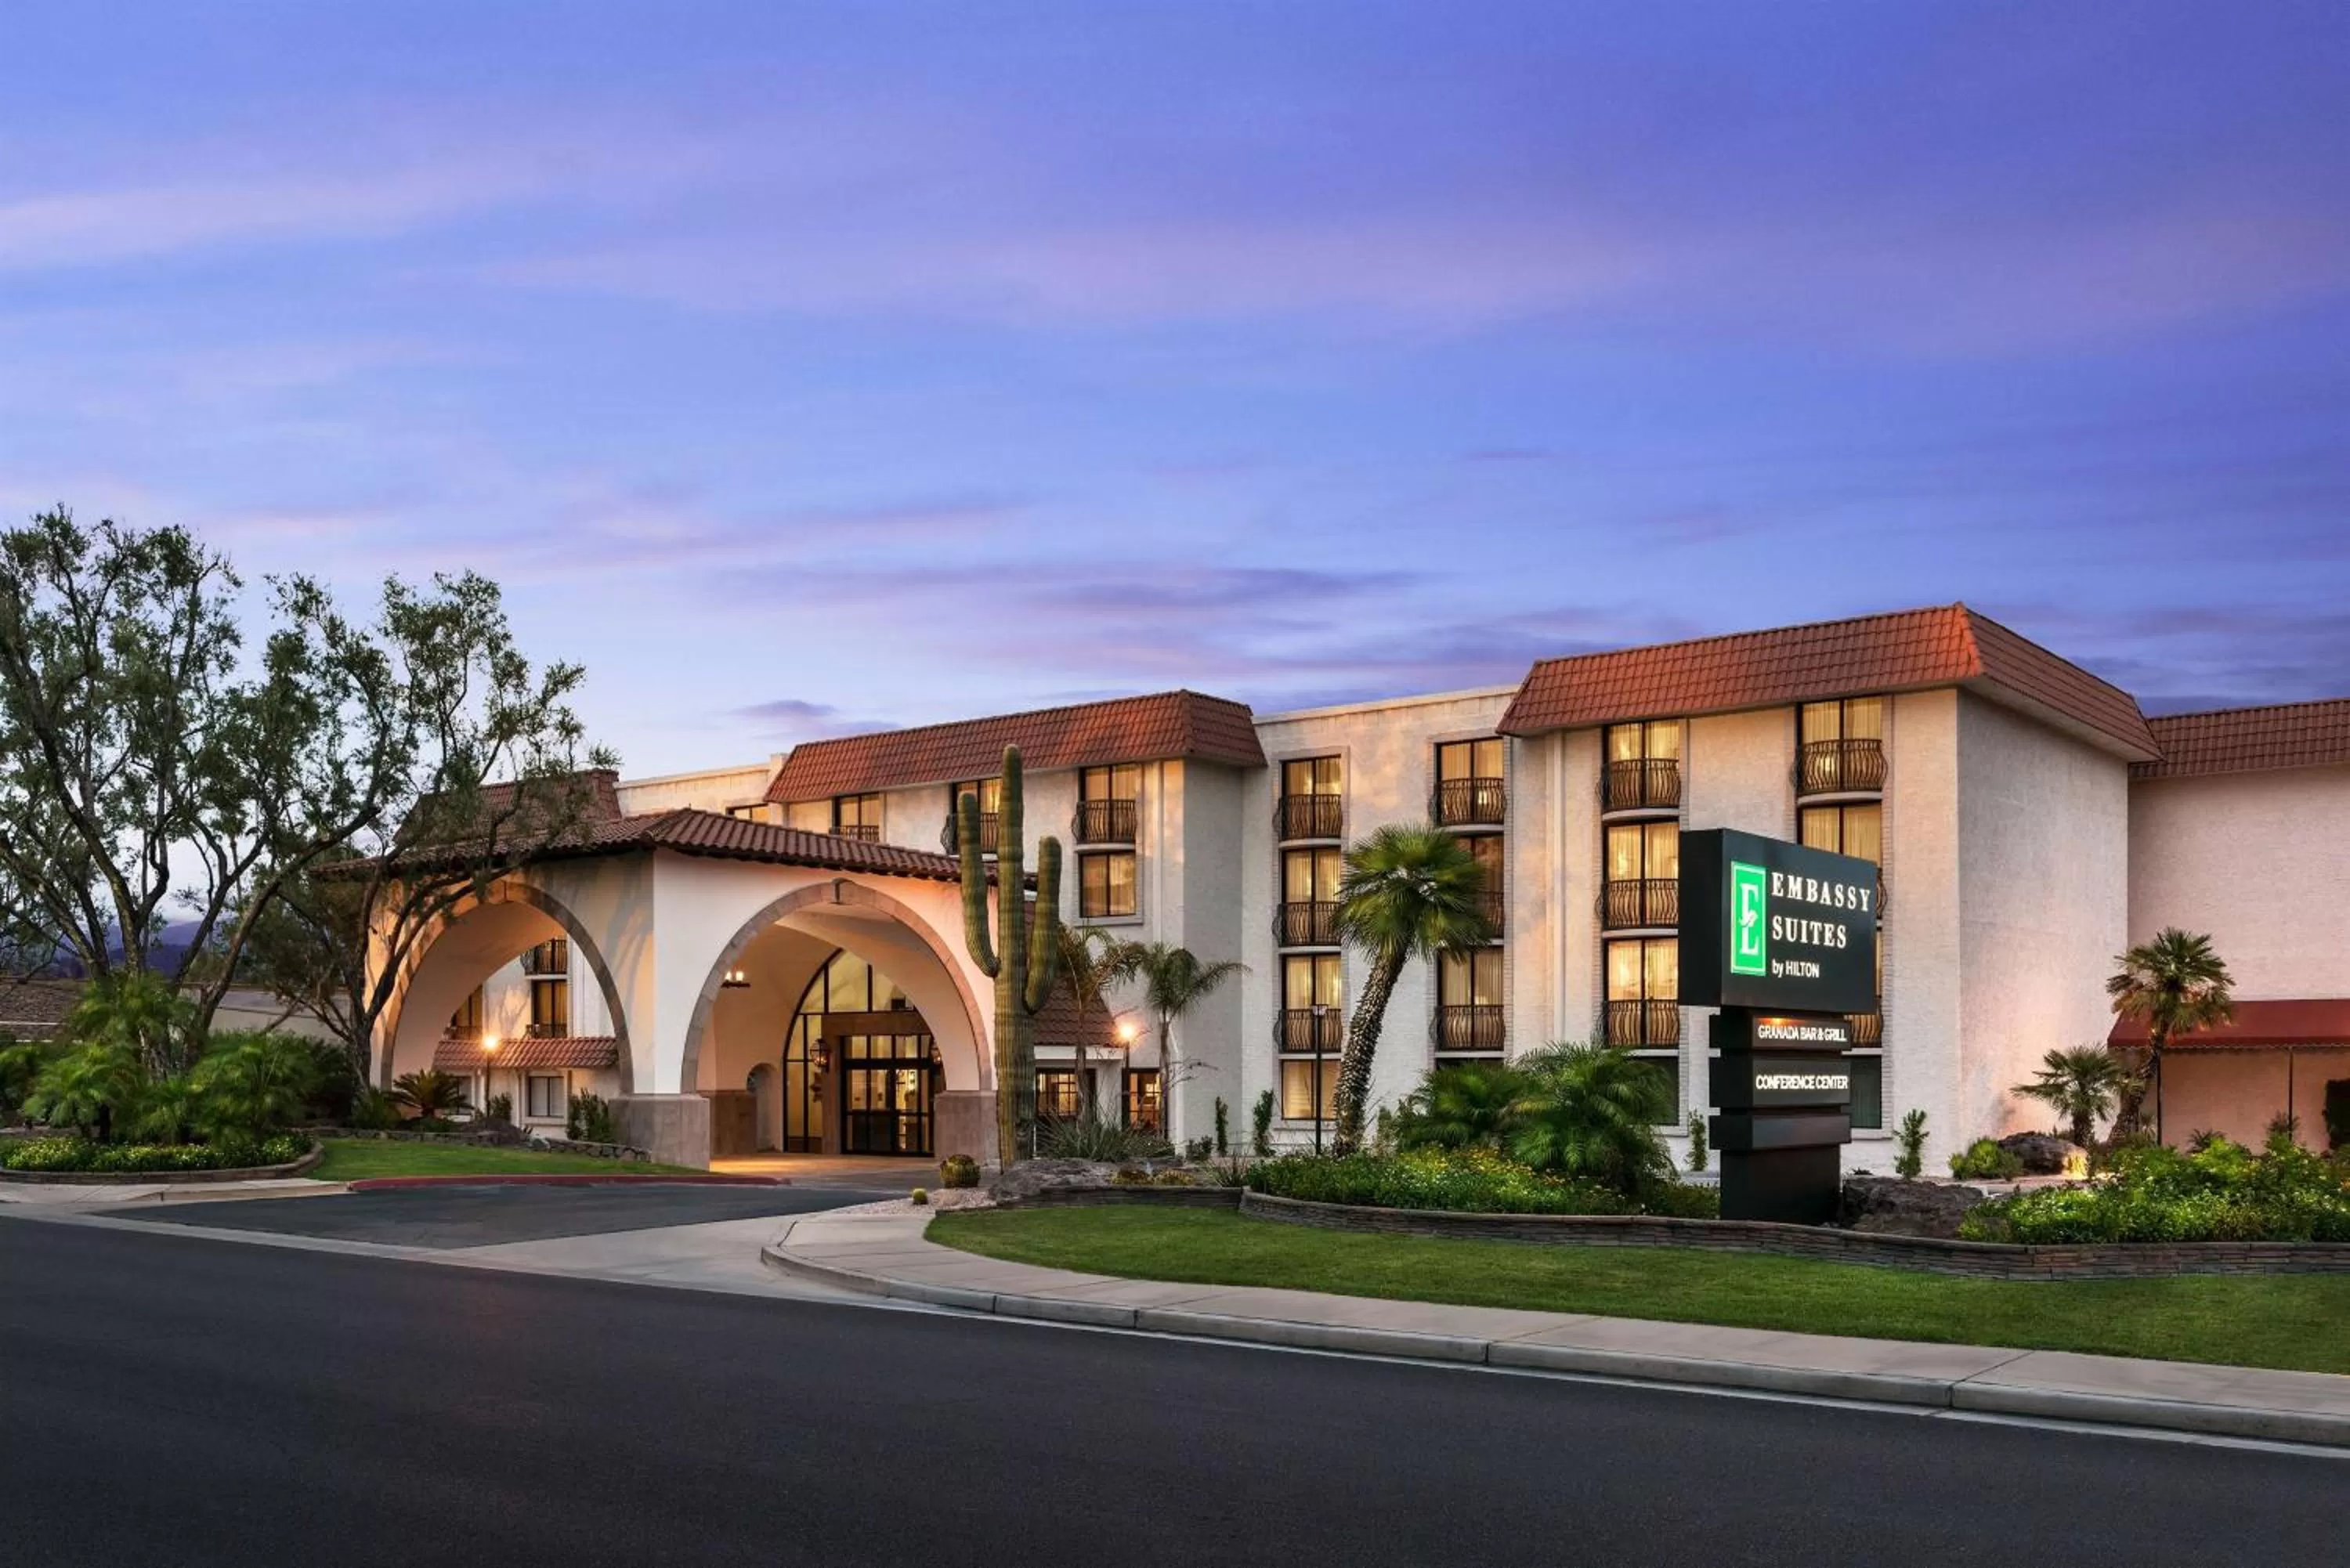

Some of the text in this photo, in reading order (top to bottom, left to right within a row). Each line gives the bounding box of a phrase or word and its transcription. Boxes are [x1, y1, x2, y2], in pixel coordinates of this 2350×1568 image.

[1771, 872, 1871, 912] EMBASSY
[1772, 915, 1847, 948] SUITES
[1772, 959, 1820, 977] by HILTON
[1758, 1025, 1847, 1042] GRANADA BAR & GRILL
[1755, 1075, 1849, 1089] CONFERENCE CENTER
